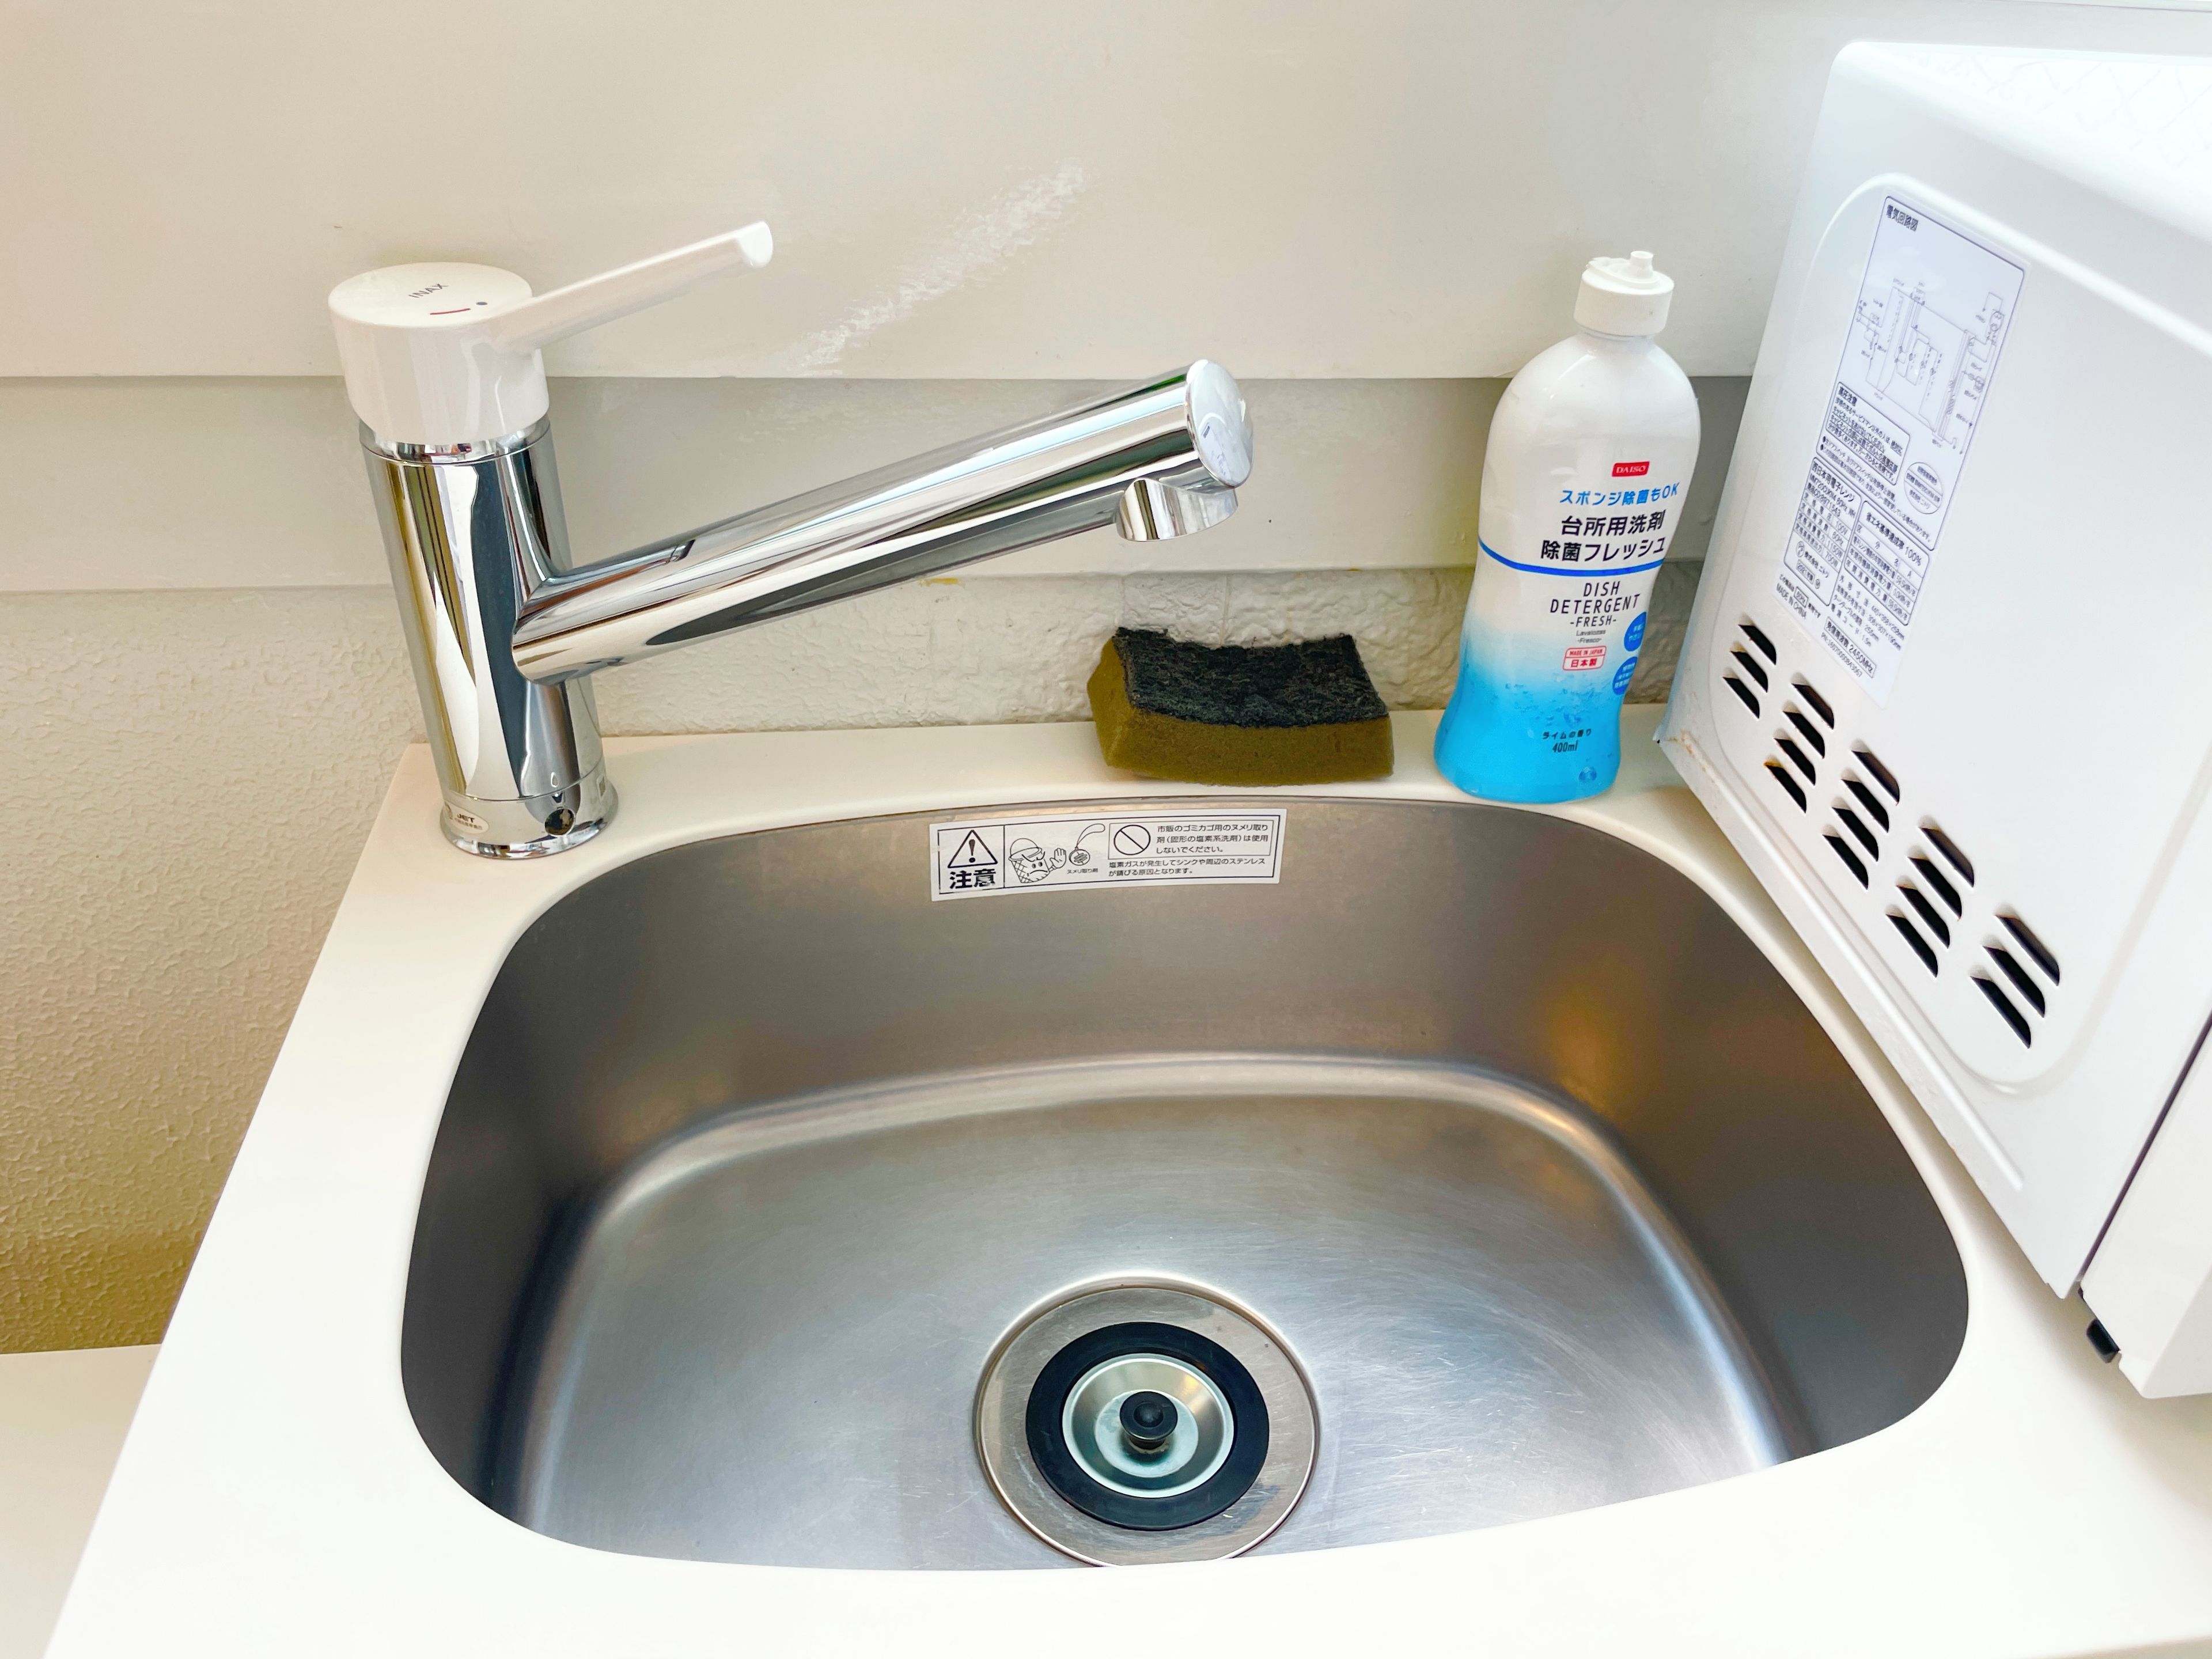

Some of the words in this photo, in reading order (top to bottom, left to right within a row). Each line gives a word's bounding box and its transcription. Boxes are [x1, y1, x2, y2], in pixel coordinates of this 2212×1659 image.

[1885, 204, 1919, 232] 電気回路図
[408, 283, 449, 298] INAX
[1615, 464, 1647, 475] DAISO
[1811, 460, 1855, 505] 西日本用電子レンジ
[1560, 482, 1680, 506] スポンジ除菌もOK
[1560, 510, 1665, 537] 台所用洗剤
[1541, 537, 1666, 562] 除菌フレッシュ
[1904, 545, 1923, 567] 100%
[1584, 581, 1620, 597] DISH
[1550, 594, 1640, 614] DETERGENT
[1570, 616, 1616, 627] -FRESH-
[1571, 658, 1597, 668] 日本製
[1552, 740, 1578, 752] 400ml
[1157, 824, 1268, 832] 市販のゴミカゴ用のヌメリ取り
[949, 868, 997, 889] 注意
